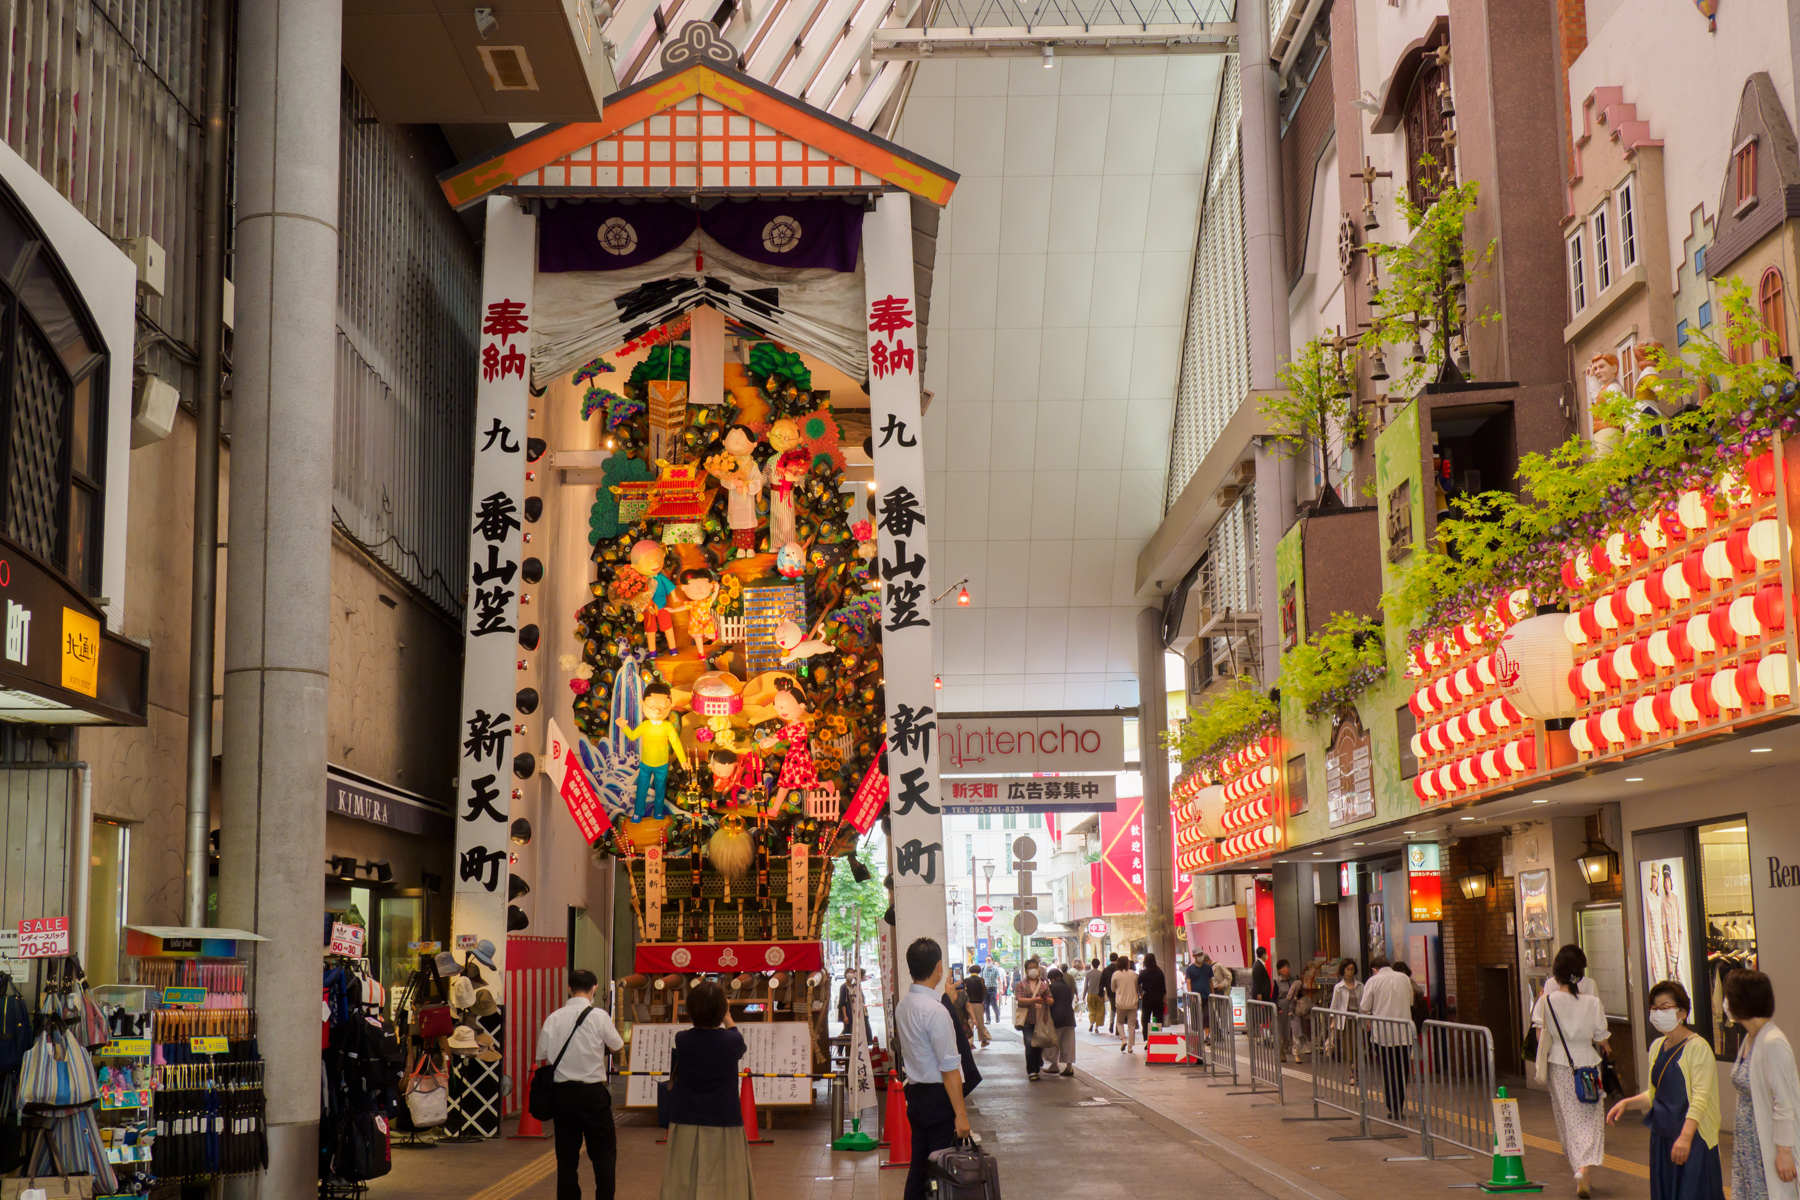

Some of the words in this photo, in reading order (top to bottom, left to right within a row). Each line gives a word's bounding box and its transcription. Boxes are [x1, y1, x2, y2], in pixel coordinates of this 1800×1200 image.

[482, 297, 529, 384] 奉納
[868, 294, 915, 380] 奉納
[5, 598, 32, 667] 町
[66, 632, 98, 667] 北通り
[338, 789, 388, 824] KIMURA
[460, 709, 512, 892] 新天町
[888, 703, 942, 885] 新天町
[951, 805, 968, 814] TEL
[969, 805, 1025, 814] 092-741-8331
[952, 782, 998, 799] 新天町
[1007, 780, 1099, 800] 広告募集中
[1766, 855, 1800, 889] Ren
[648, 879, 659, 932] 新天町
[794, 860, 806, 931] サザエさん
[21, 931, 66, 942] レディースバッグ
[23, 918, 63, 933] SALE
[979, 943, 987, 951] P
[1500, 1103, 1517, 1149] 歩行者専用通路
